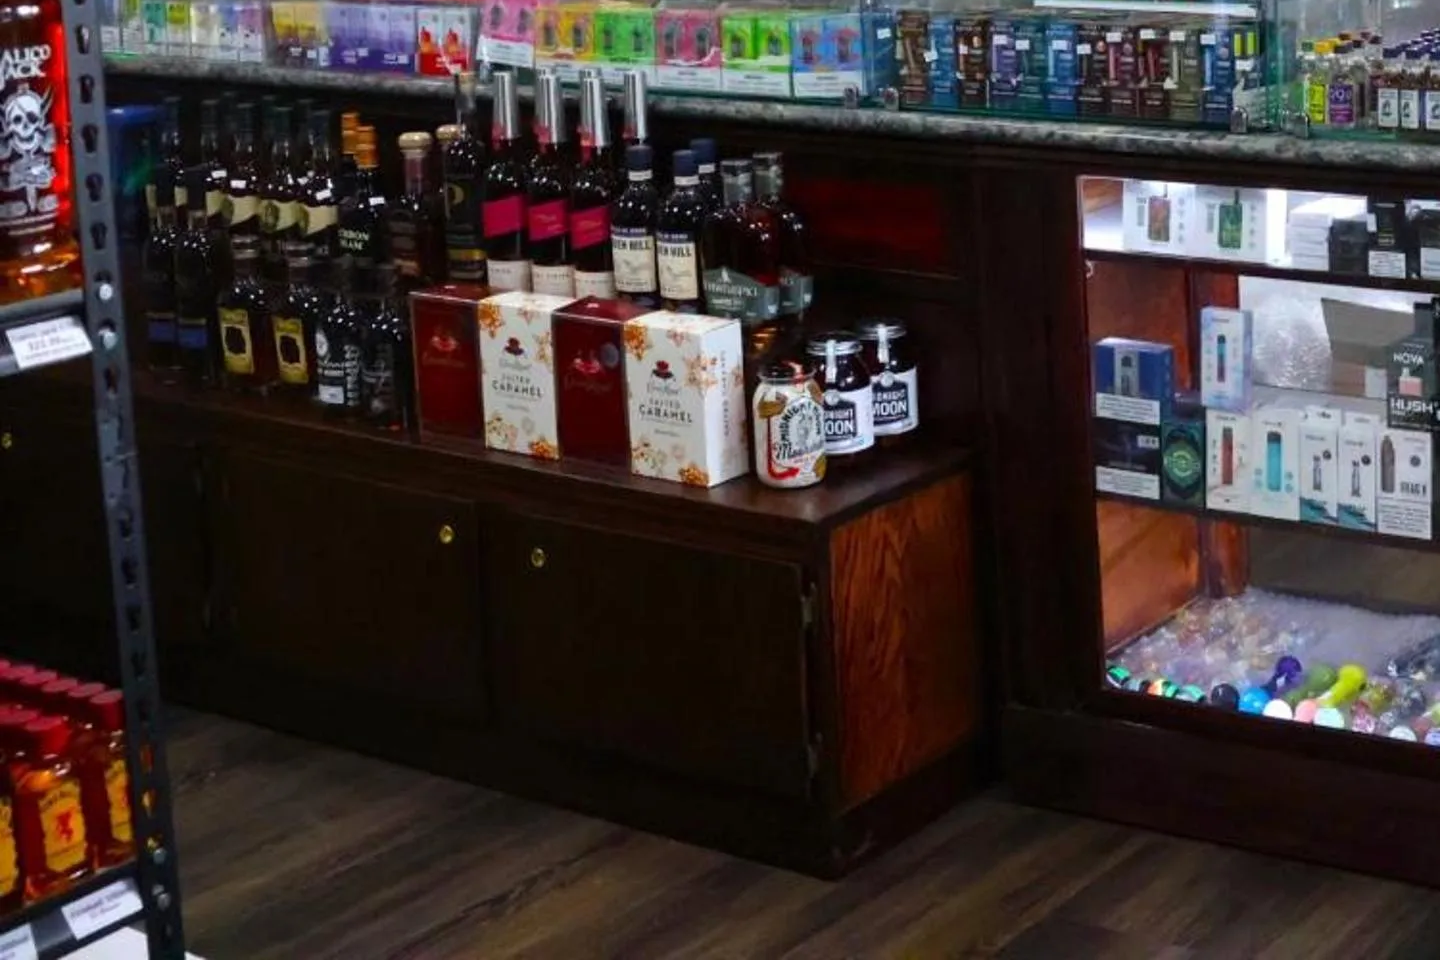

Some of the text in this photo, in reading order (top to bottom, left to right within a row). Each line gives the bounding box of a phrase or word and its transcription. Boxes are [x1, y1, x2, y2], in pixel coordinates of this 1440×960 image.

[0, 44, 51, 63] ALICO
[1393, 352, 1424, 365] NOVA
[492, 380, 543, 398] CARAMEL
[638, 404, 693, 423] CARAMEL
[1390, 398, 1434, 415] HUSH
[824, 420, 855, 435] OON
